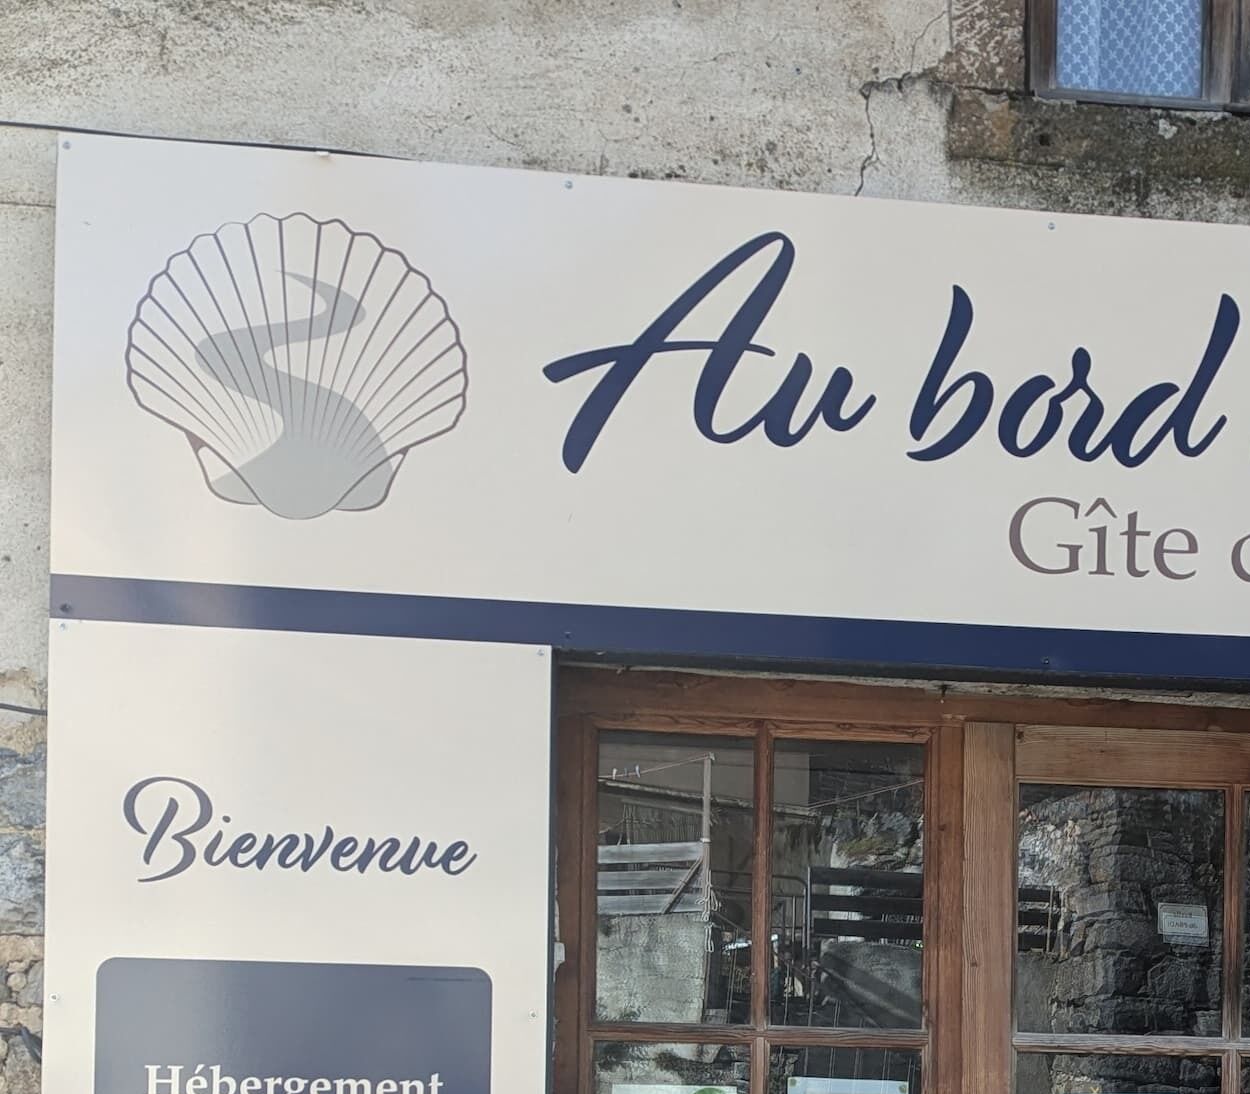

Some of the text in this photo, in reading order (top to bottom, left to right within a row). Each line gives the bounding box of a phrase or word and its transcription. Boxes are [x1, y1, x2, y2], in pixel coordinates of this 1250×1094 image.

[543, 232, 876, 473] Au
[907, 285, 1241, 468] bord
[1009, 497, 1199, 580] Gîte
[124, 777, 477, 882] Bienvenue
